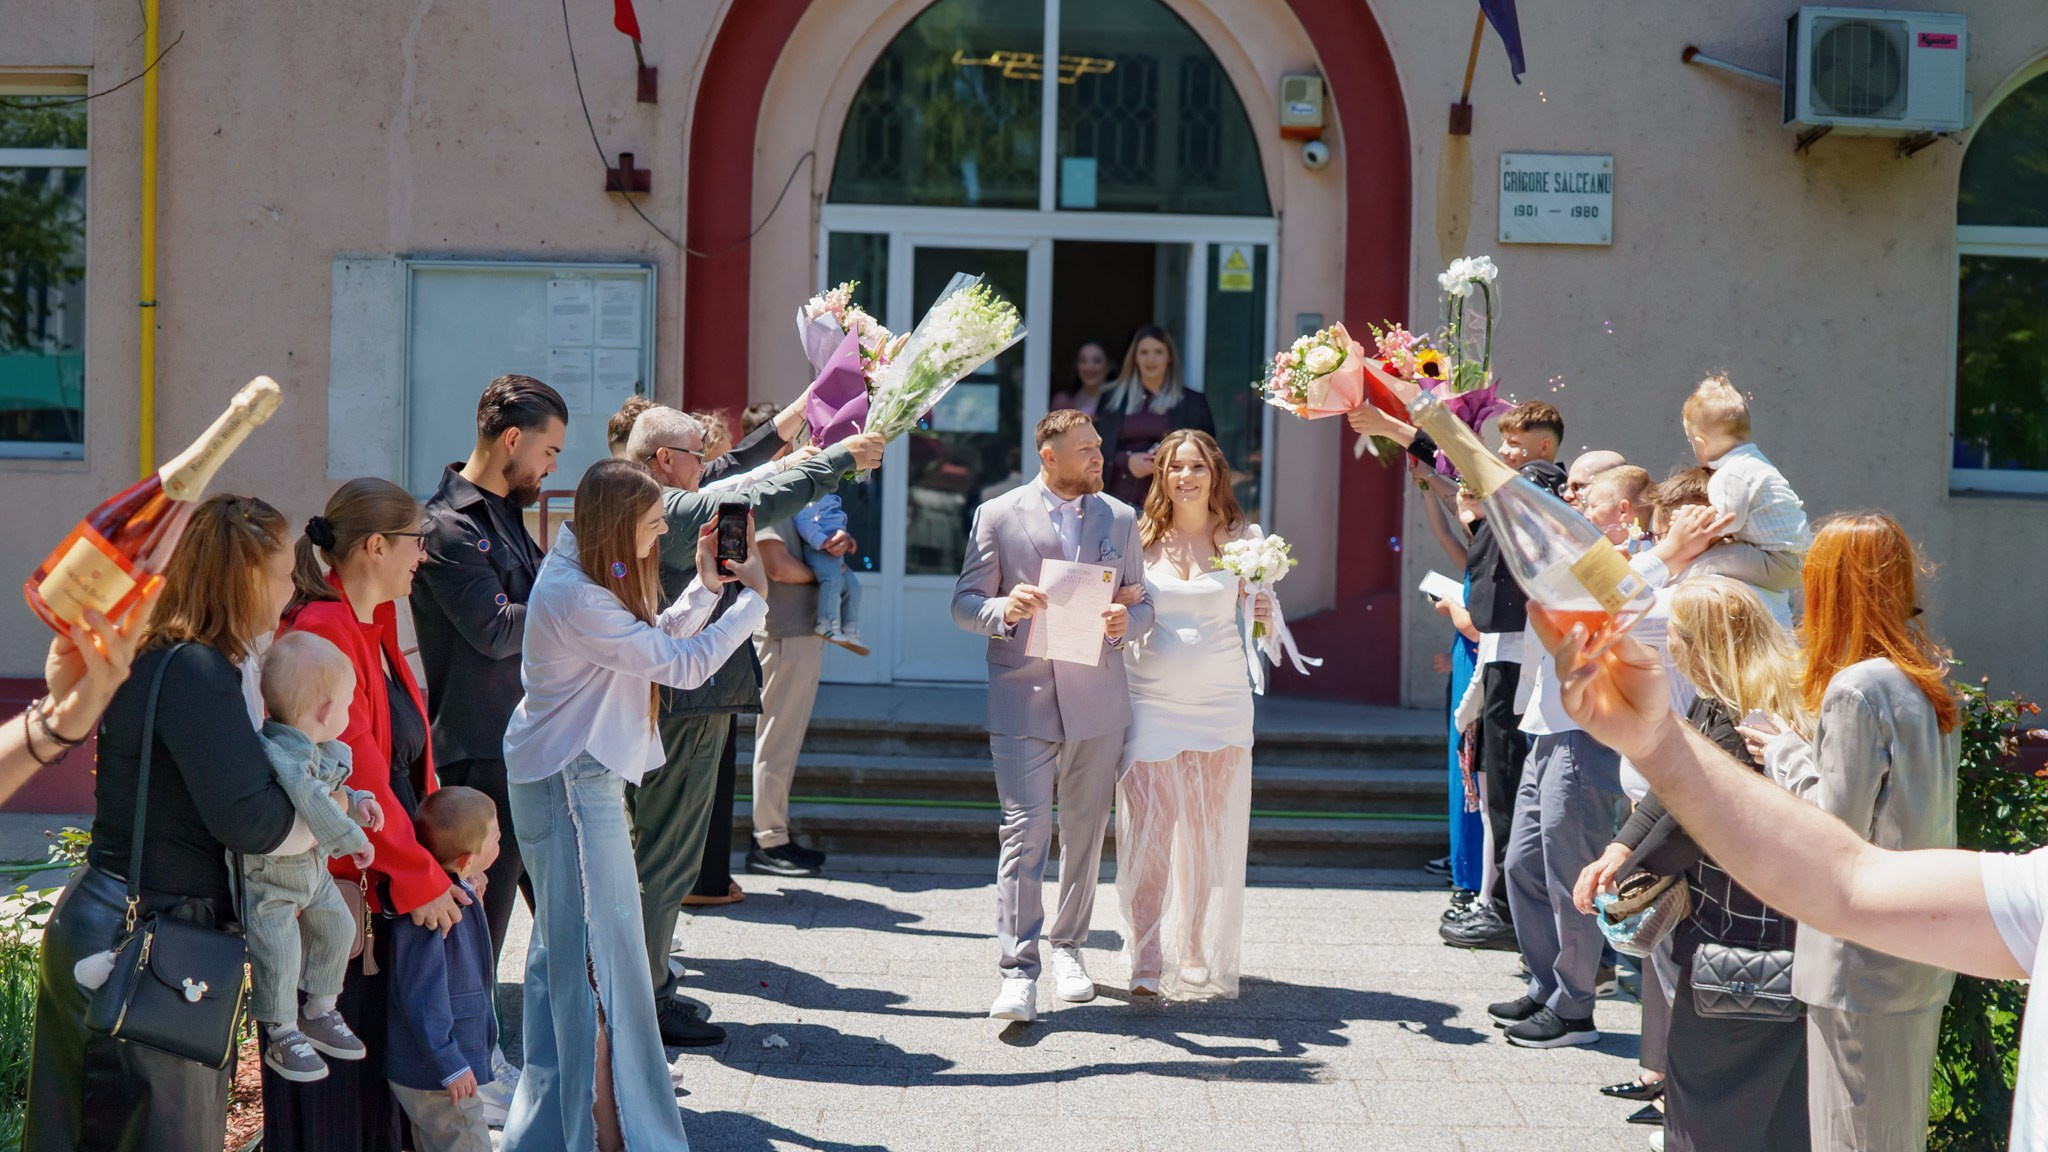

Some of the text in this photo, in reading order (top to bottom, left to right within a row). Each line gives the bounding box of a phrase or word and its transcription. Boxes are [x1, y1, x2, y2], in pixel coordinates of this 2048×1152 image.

[1503, 169, 1550, 193] GRIGORE
[1513, 204, 1538, 217] 1901
[1571, 205, 1599, 218] 1980
